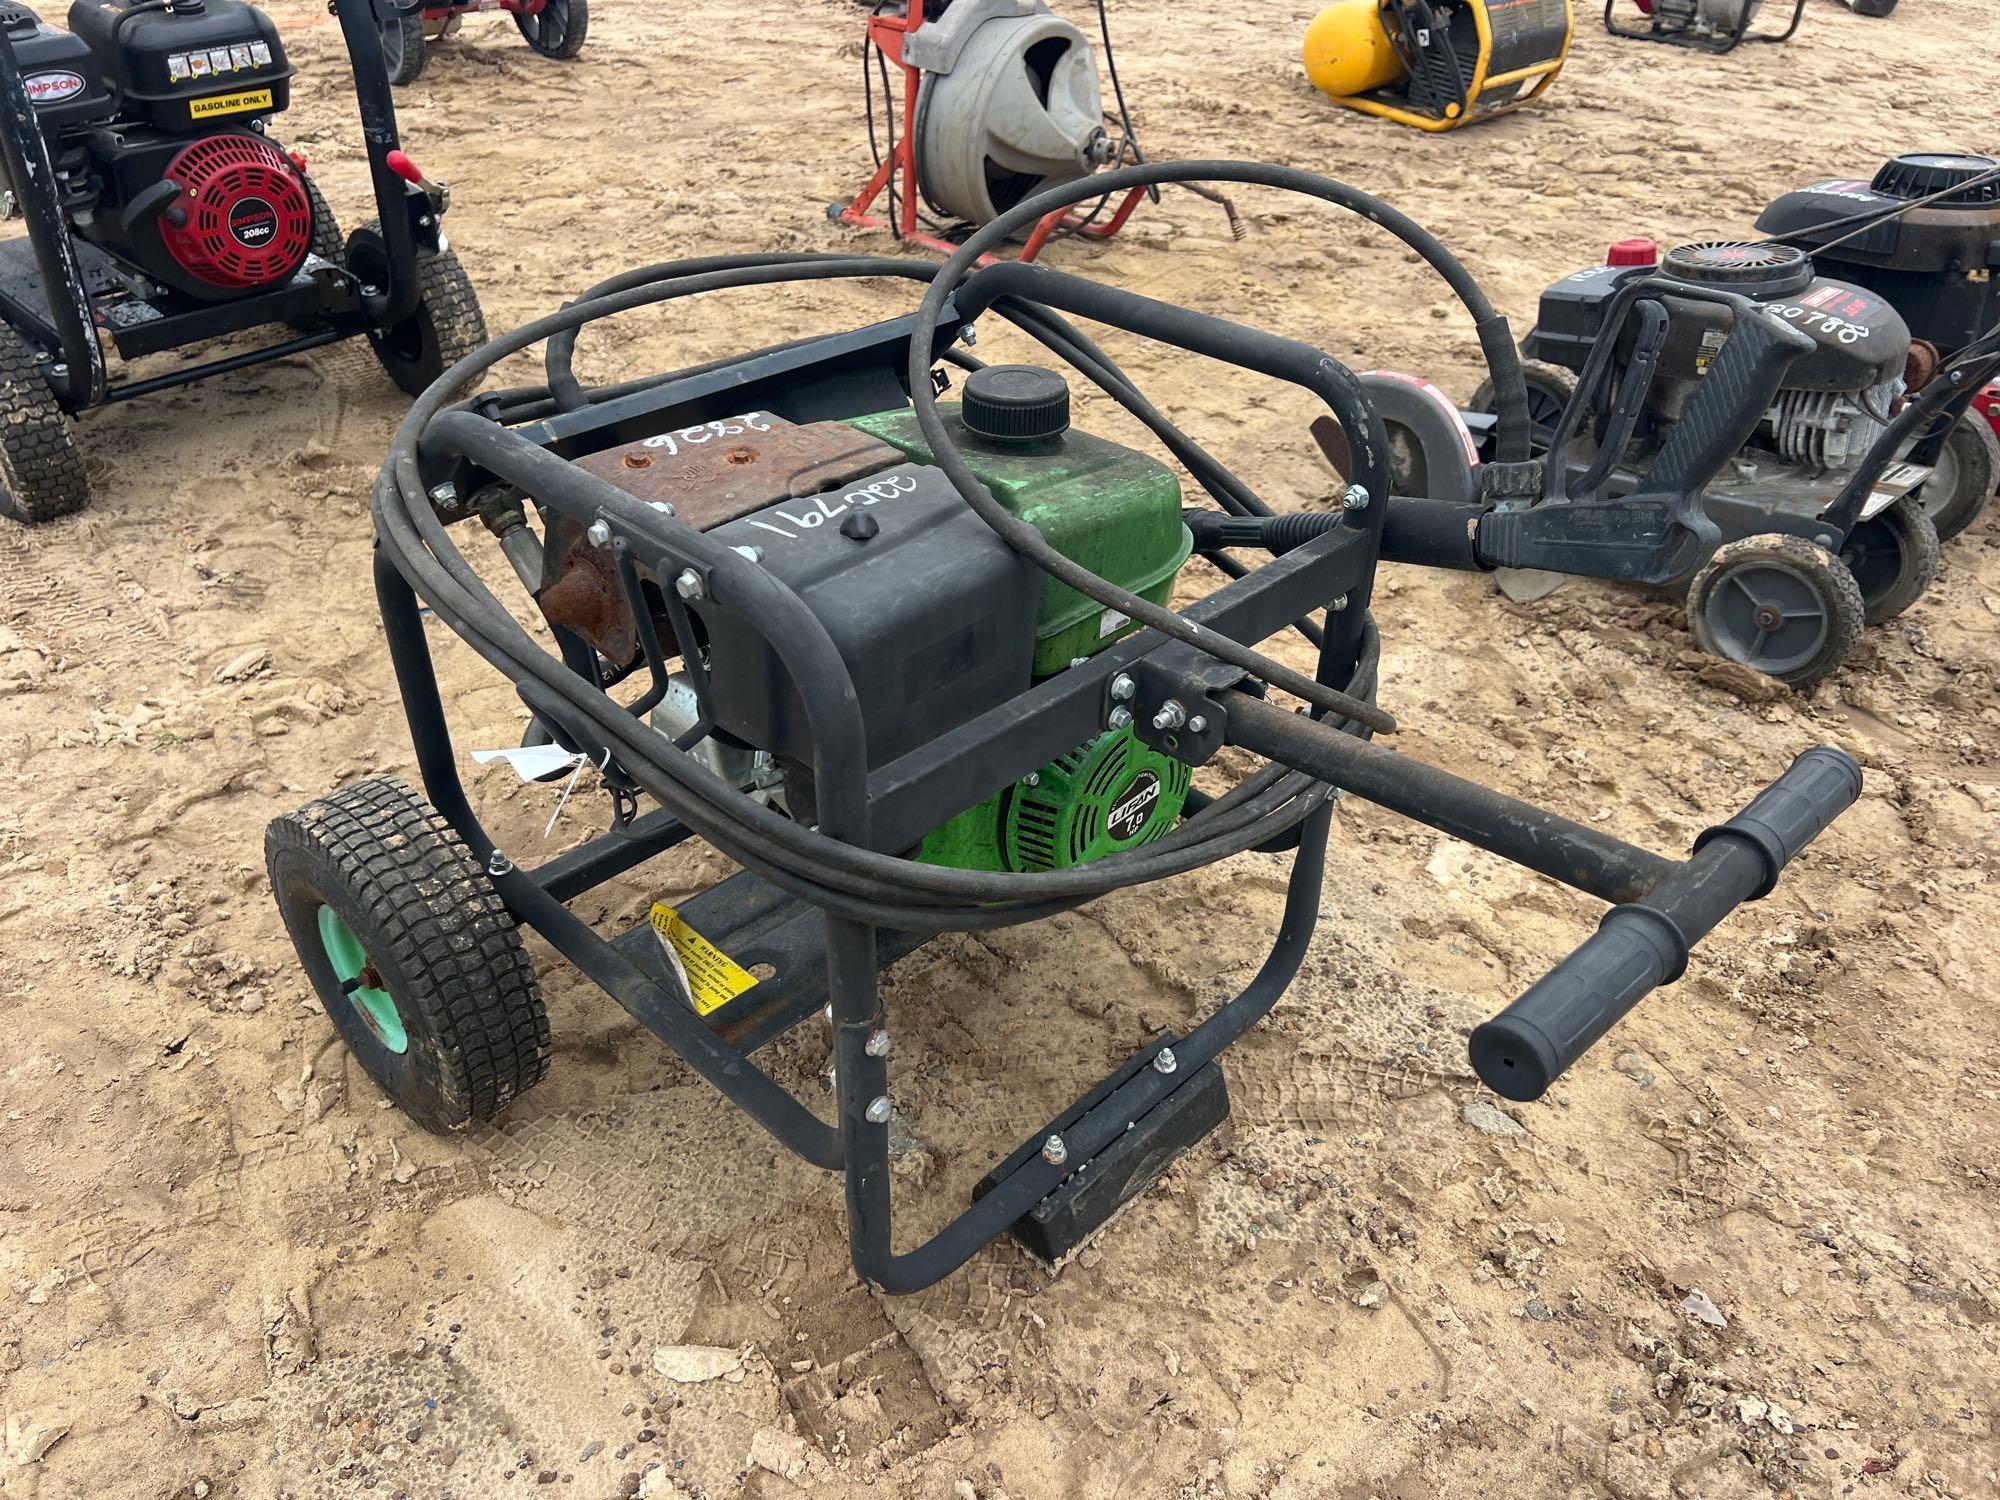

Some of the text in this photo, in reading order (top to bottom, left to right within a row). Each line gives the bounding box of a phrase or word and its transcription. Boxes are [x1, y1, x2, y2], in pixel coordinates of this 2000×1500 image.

[27, 79, 77, 94] IMPSON
[194, 95, 268, 112] GASOLINE ONLY
[230, 211, 273, 228] SIMPSON
[243, 227, 269, 239] 208cc
[1111, 785, 1157, 825] LIFAN
[1126, 812, 1143, 832] 7.0
[700, 945, 727, 968] WARNING
